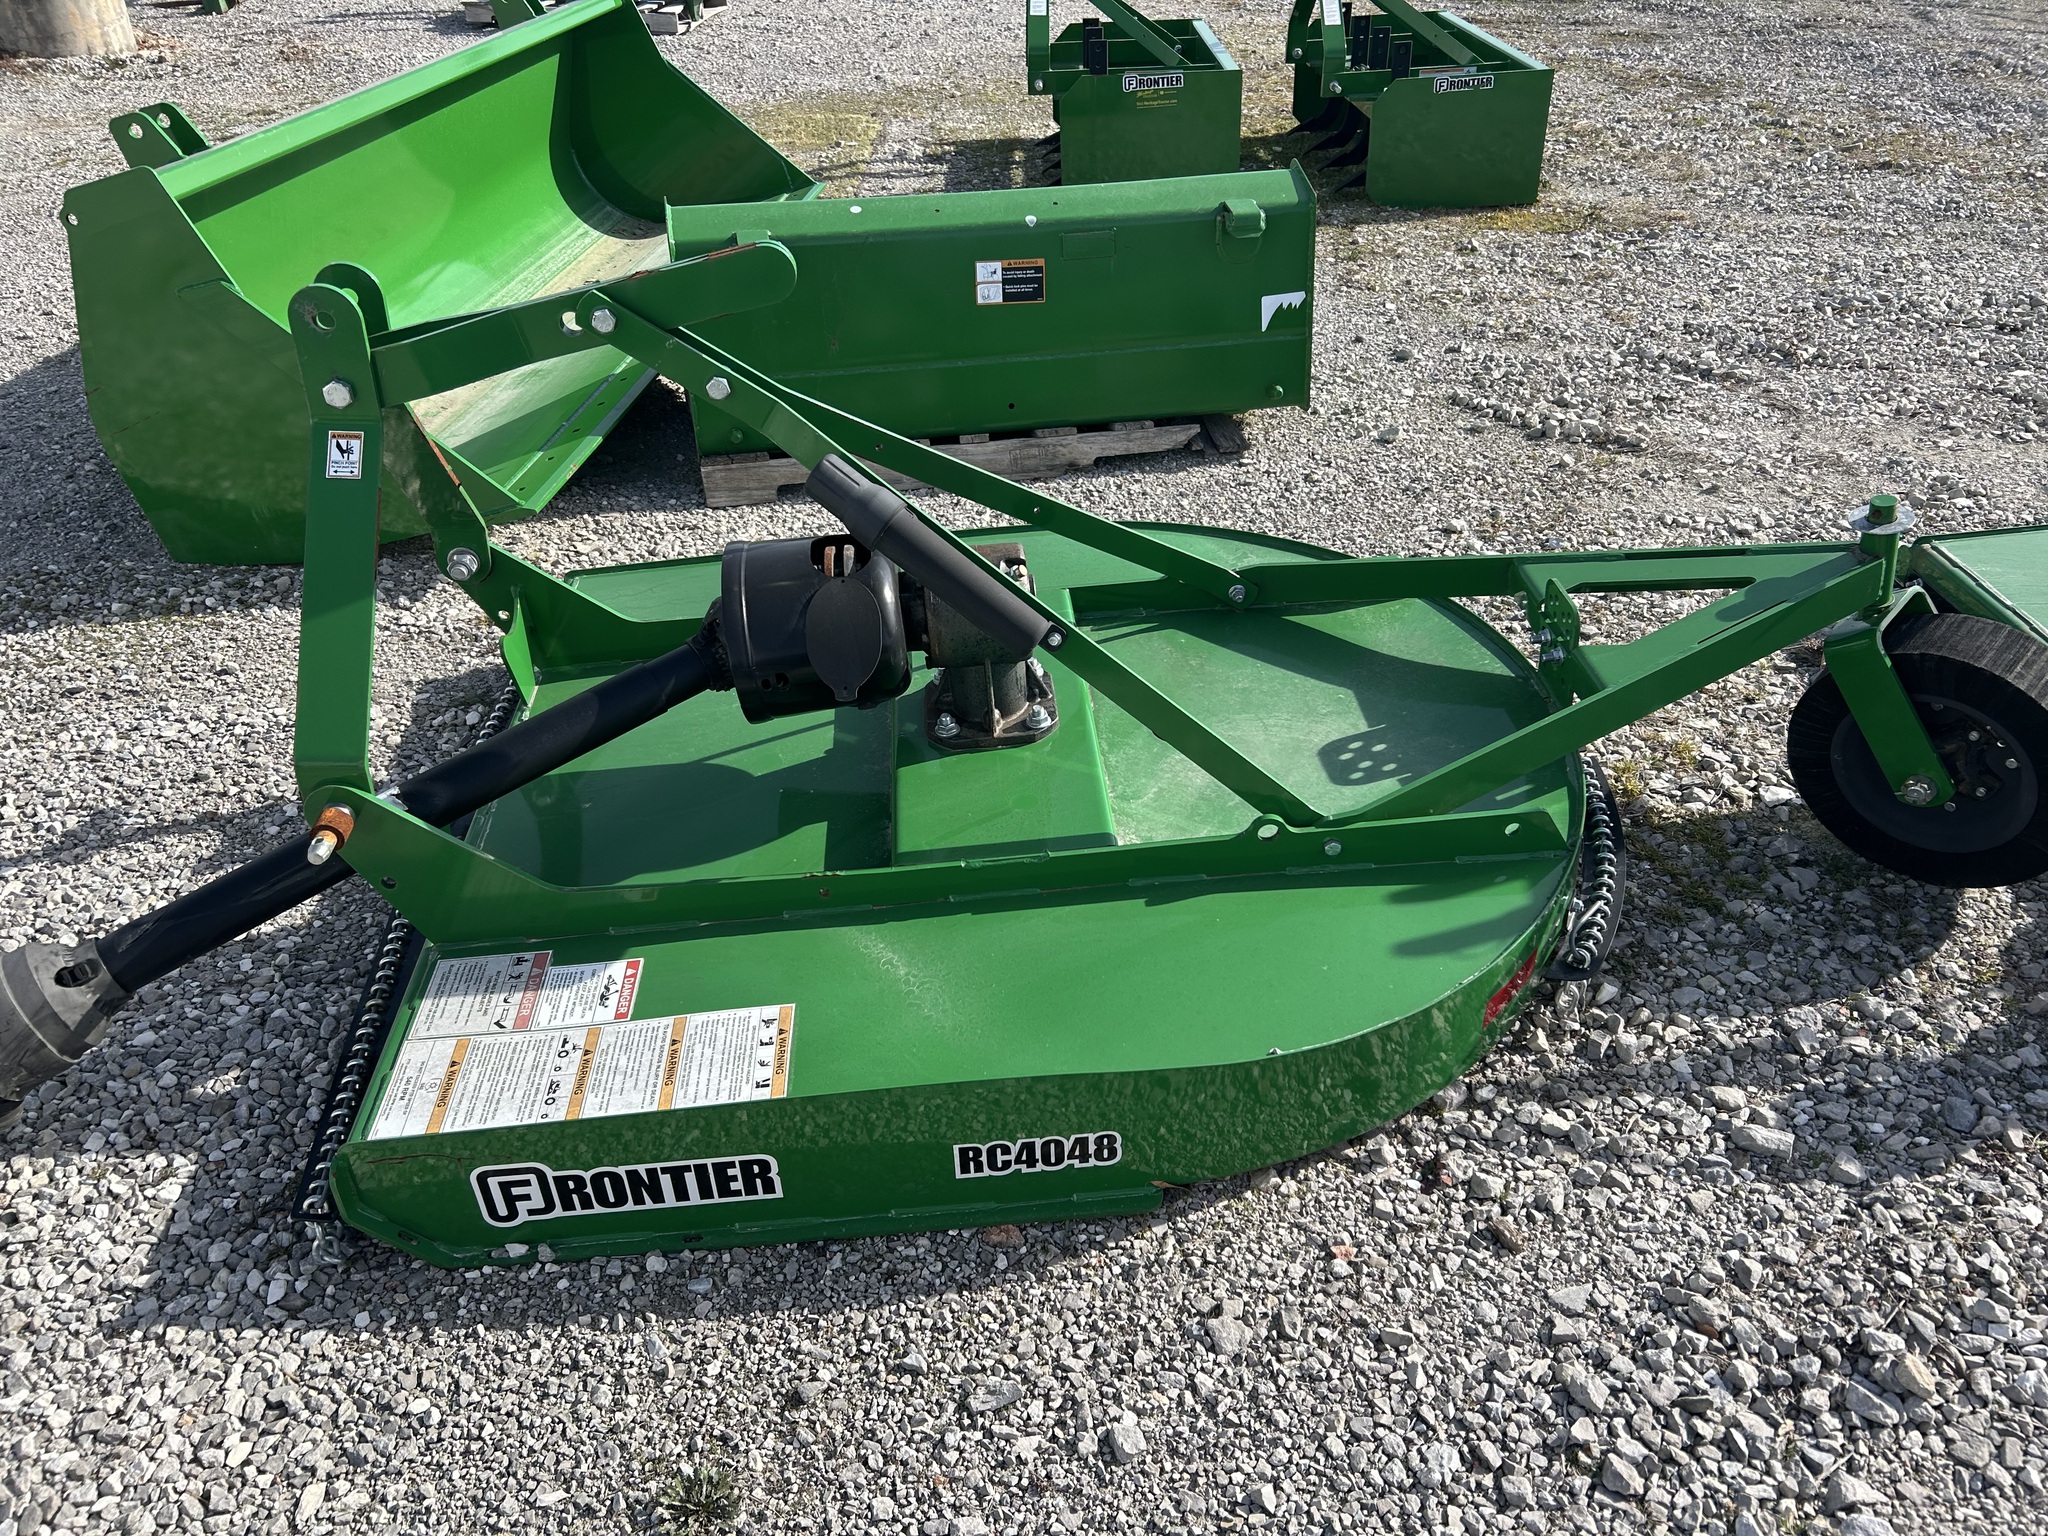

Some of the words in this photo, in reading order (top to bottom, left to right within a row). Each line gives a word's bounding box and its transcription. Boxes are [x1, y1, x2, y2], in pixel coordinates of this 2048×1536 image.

[1124, 75, 1182, 91] FRONTIER
[518, 978, 539, 1016] DANGER
[616, 977, 634, 1014] DANGER
[664, 1047, 679, 1086] WARNING
[774, 1036, 787, 1075] WARNING
[398, 1087, 409, 1100] RPM
[403, 1076, 413, 1086] 540
[436, 1069, 457, 1107] WARNING
[573, 1057, 591, 1095] WARNING
[958, 1134, 1118, 1175] RC4048
[476, 1158, 776, 1223] FRONTIER
